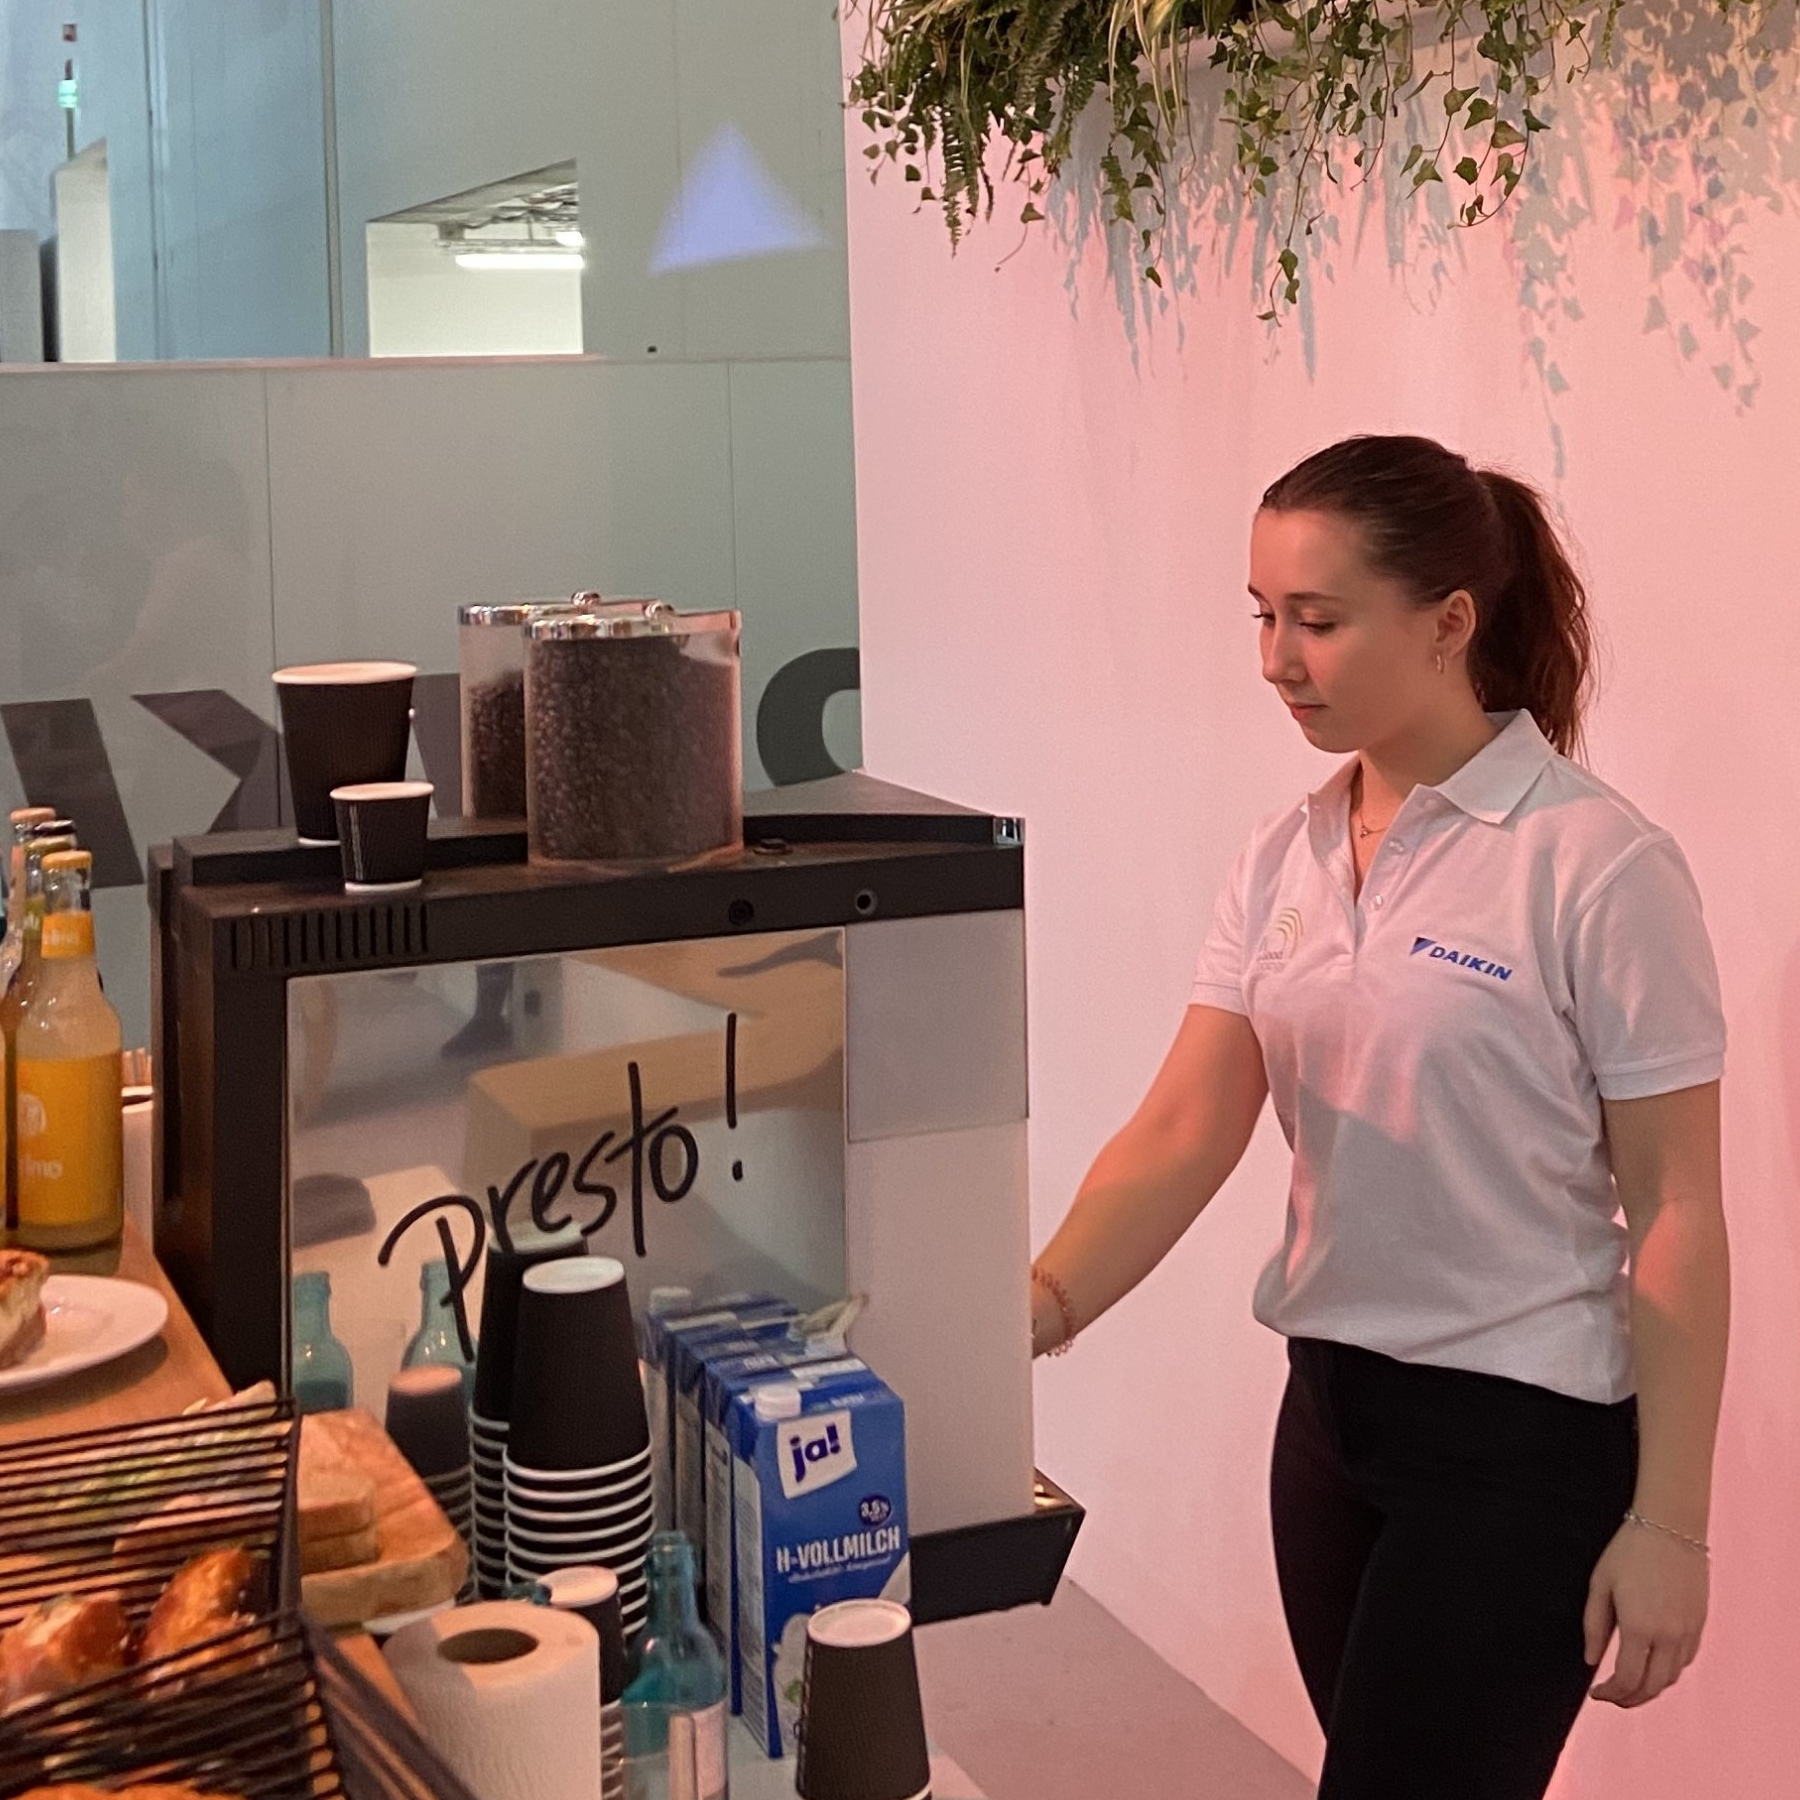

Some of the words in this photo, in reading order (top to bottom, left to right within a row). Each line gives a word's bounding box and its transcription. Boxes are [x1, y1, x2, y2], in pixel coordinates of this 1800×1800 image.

[1429, 946, 1513, 981] DAIKIN
[377, 1012, 744, 1363] Presto!
[789, 1422, 841, 1484] ja!
[776, 1525, 901, 1574] H-VOLLMILCH
